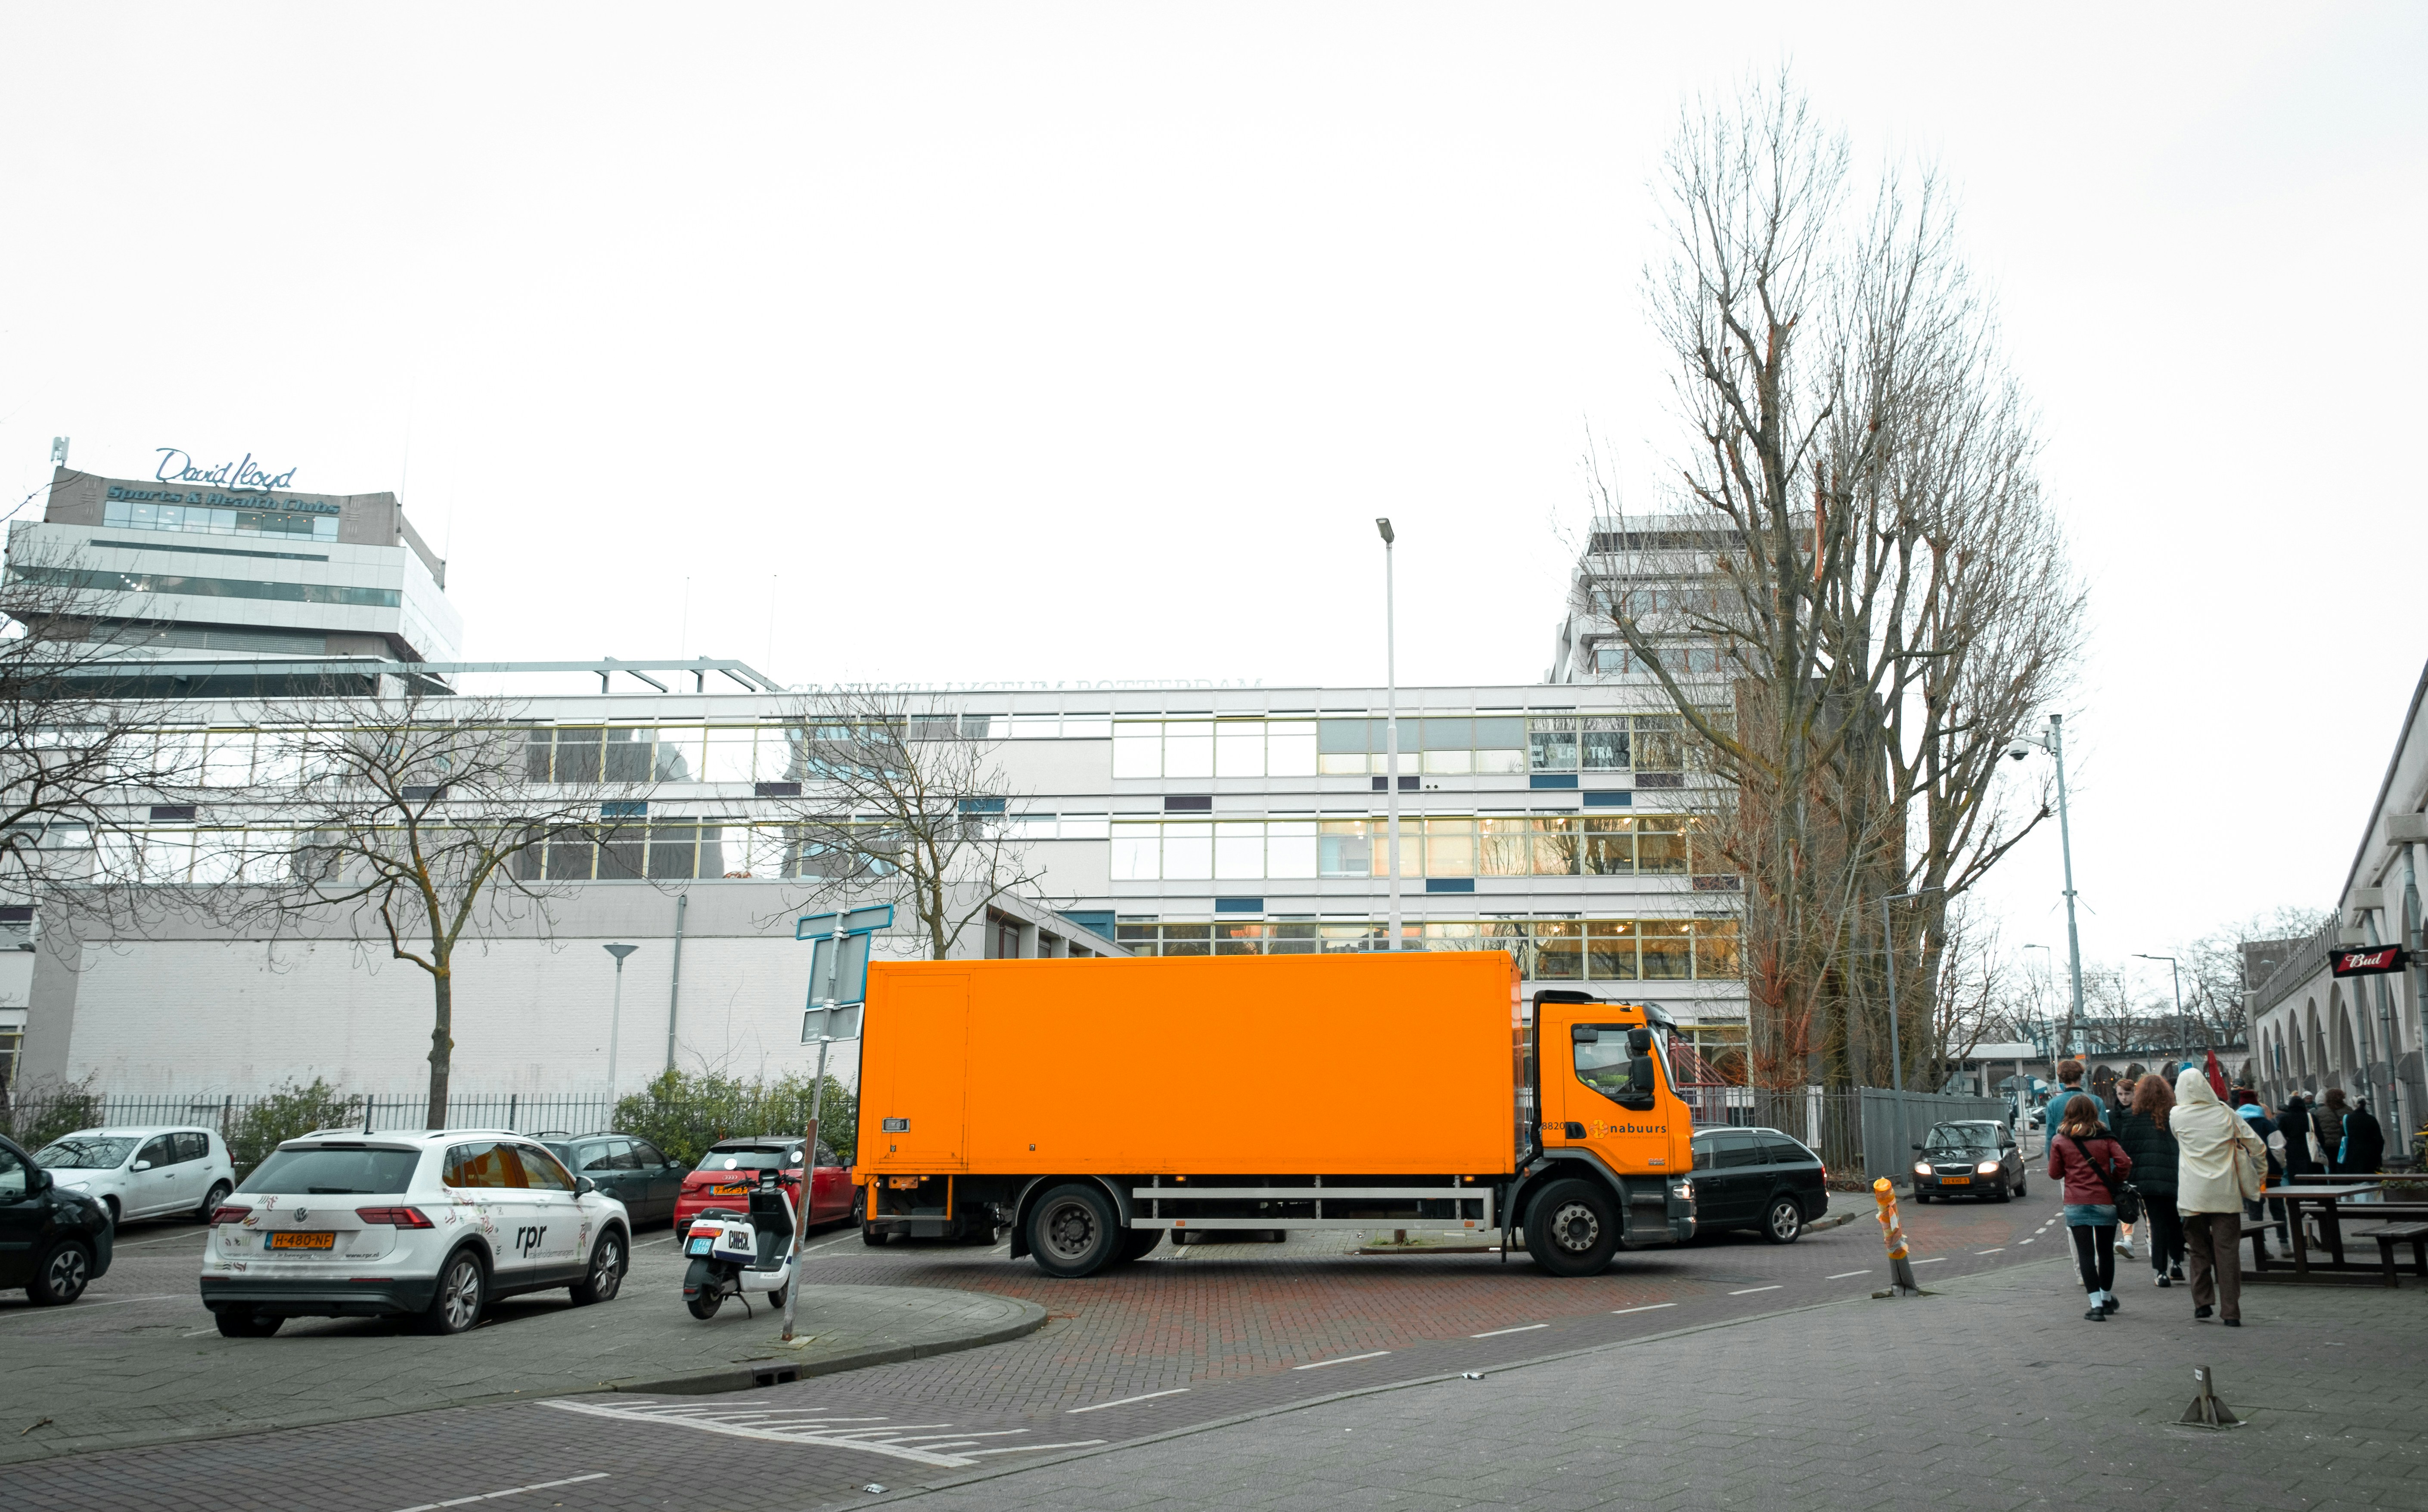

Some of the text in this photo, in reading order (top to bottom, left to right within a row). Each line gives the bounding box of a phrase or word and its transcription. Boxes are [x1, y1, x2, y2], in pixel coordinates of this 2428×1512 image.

[155, 447, 297, 494] David Lloyd
[107, 485, 341, 514] Sports & Health Clubs
[2345, 952, 2382, 968] Bud
[1542, 1122, 1565, 1130] 8820
[1610, 1123, 1667, 1133] nabuurs
[274, 1234, 331, 1246] H-480-NF
[516, 1225, 547, 1258] rpr
